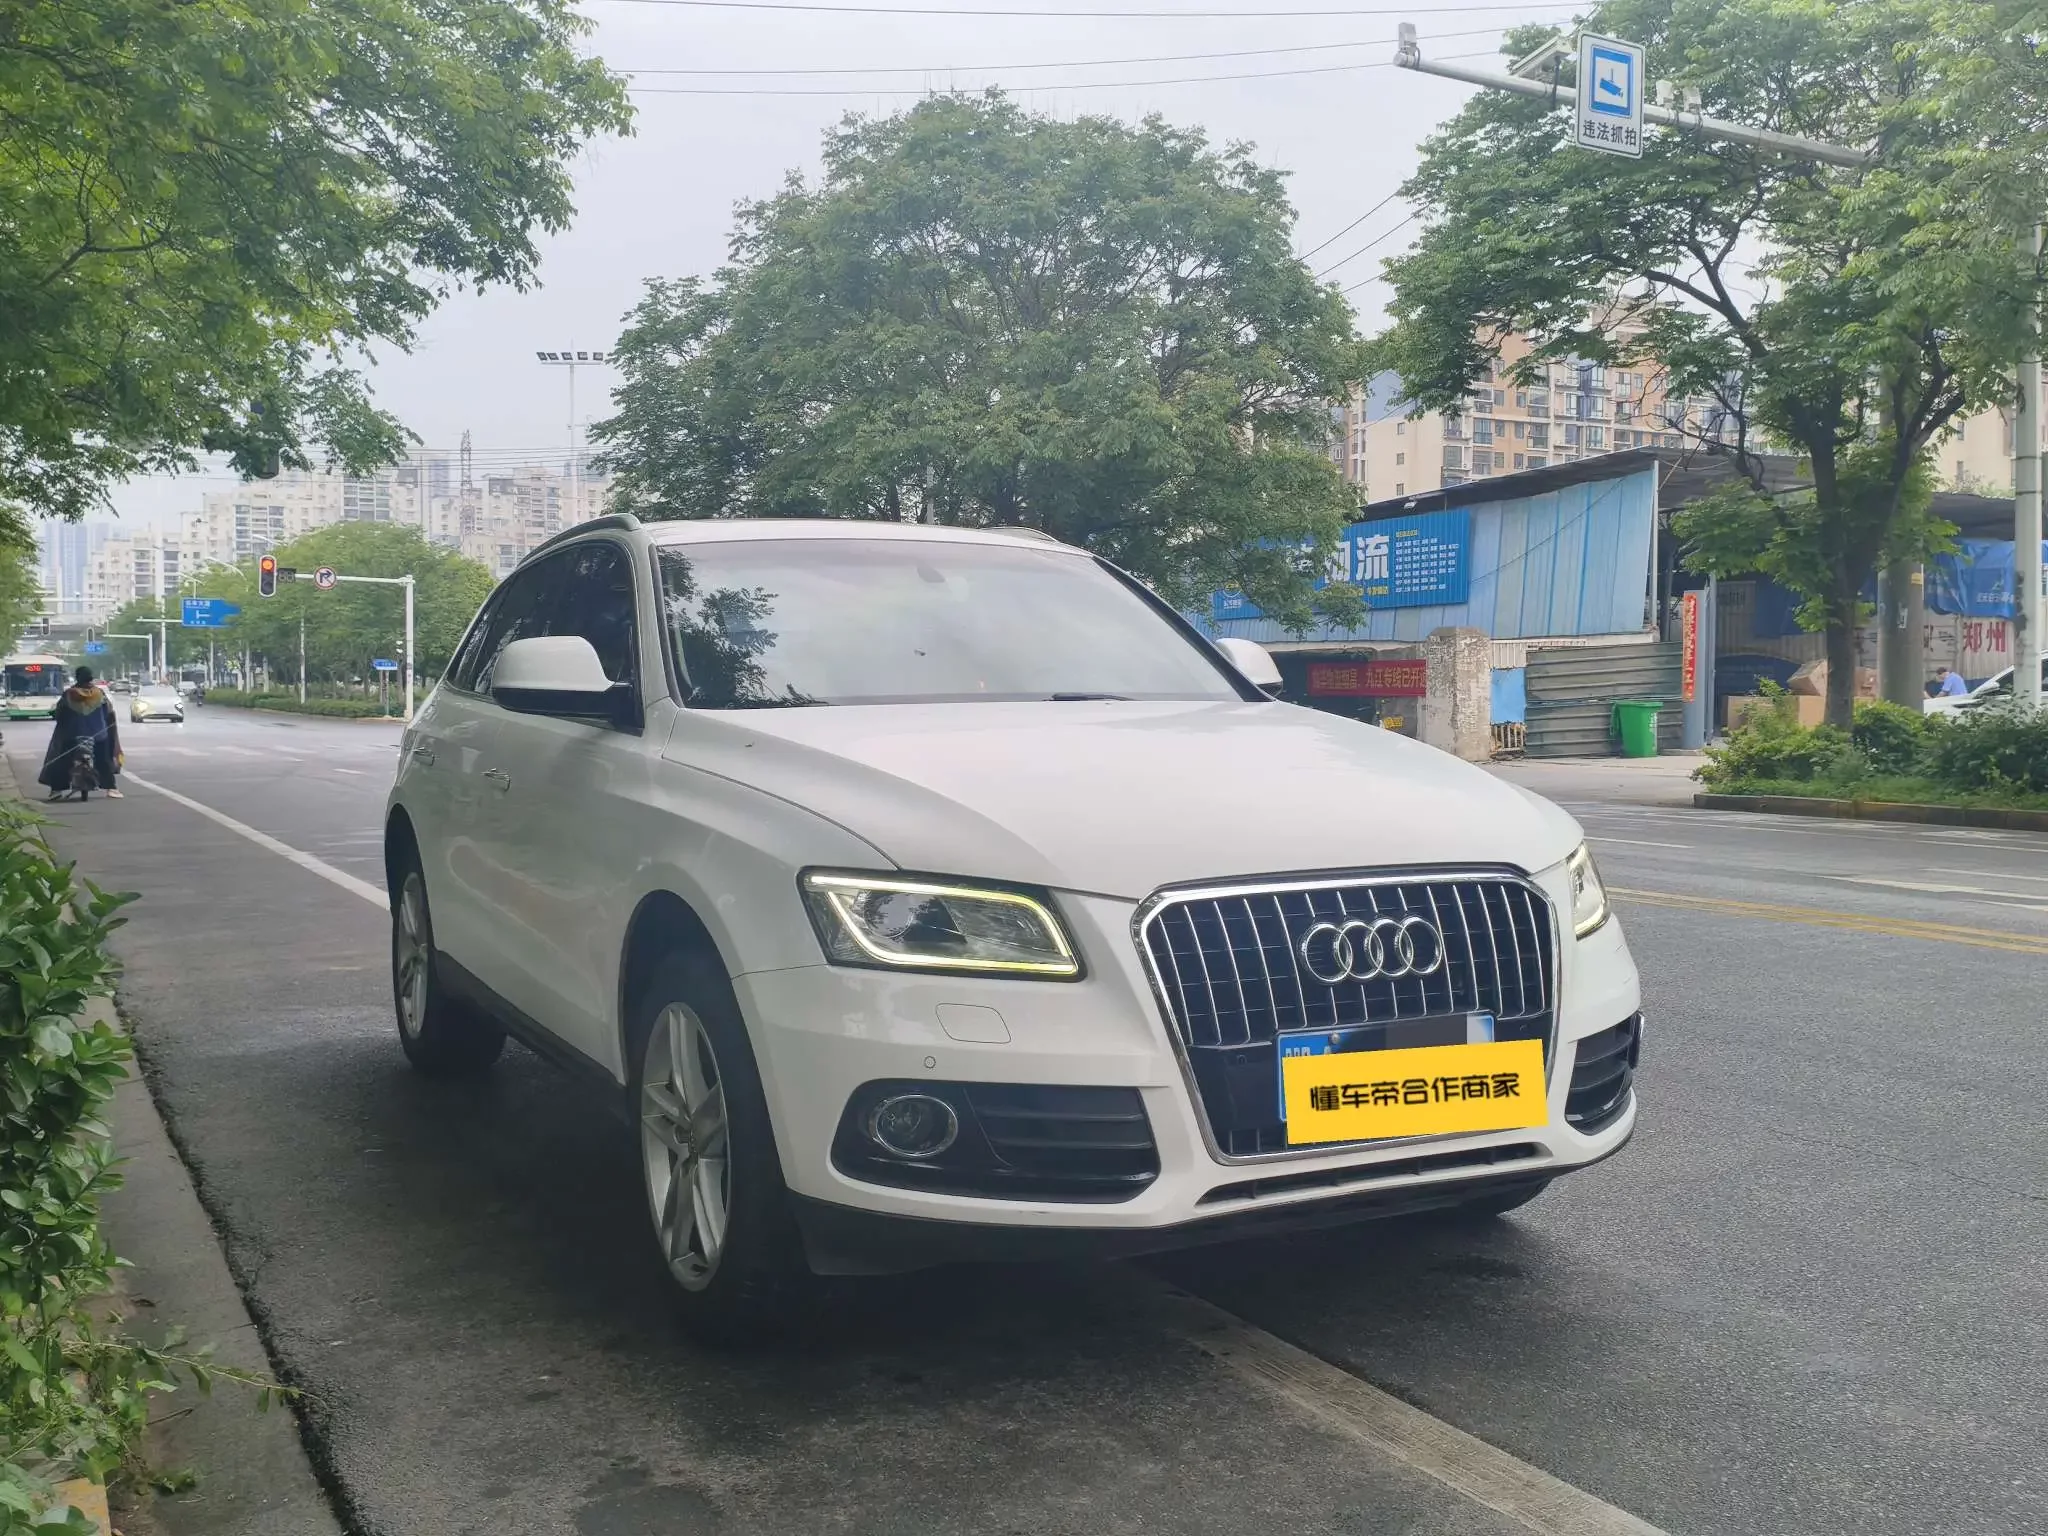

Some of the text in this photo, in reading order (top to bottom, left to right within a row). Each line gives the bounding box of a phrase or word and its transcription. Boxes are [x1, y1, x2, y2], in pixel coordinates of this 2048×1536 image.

[1583, 120, 1637, 146] 违法抓拍
[1962, 621, 2006, 652] 郑州
